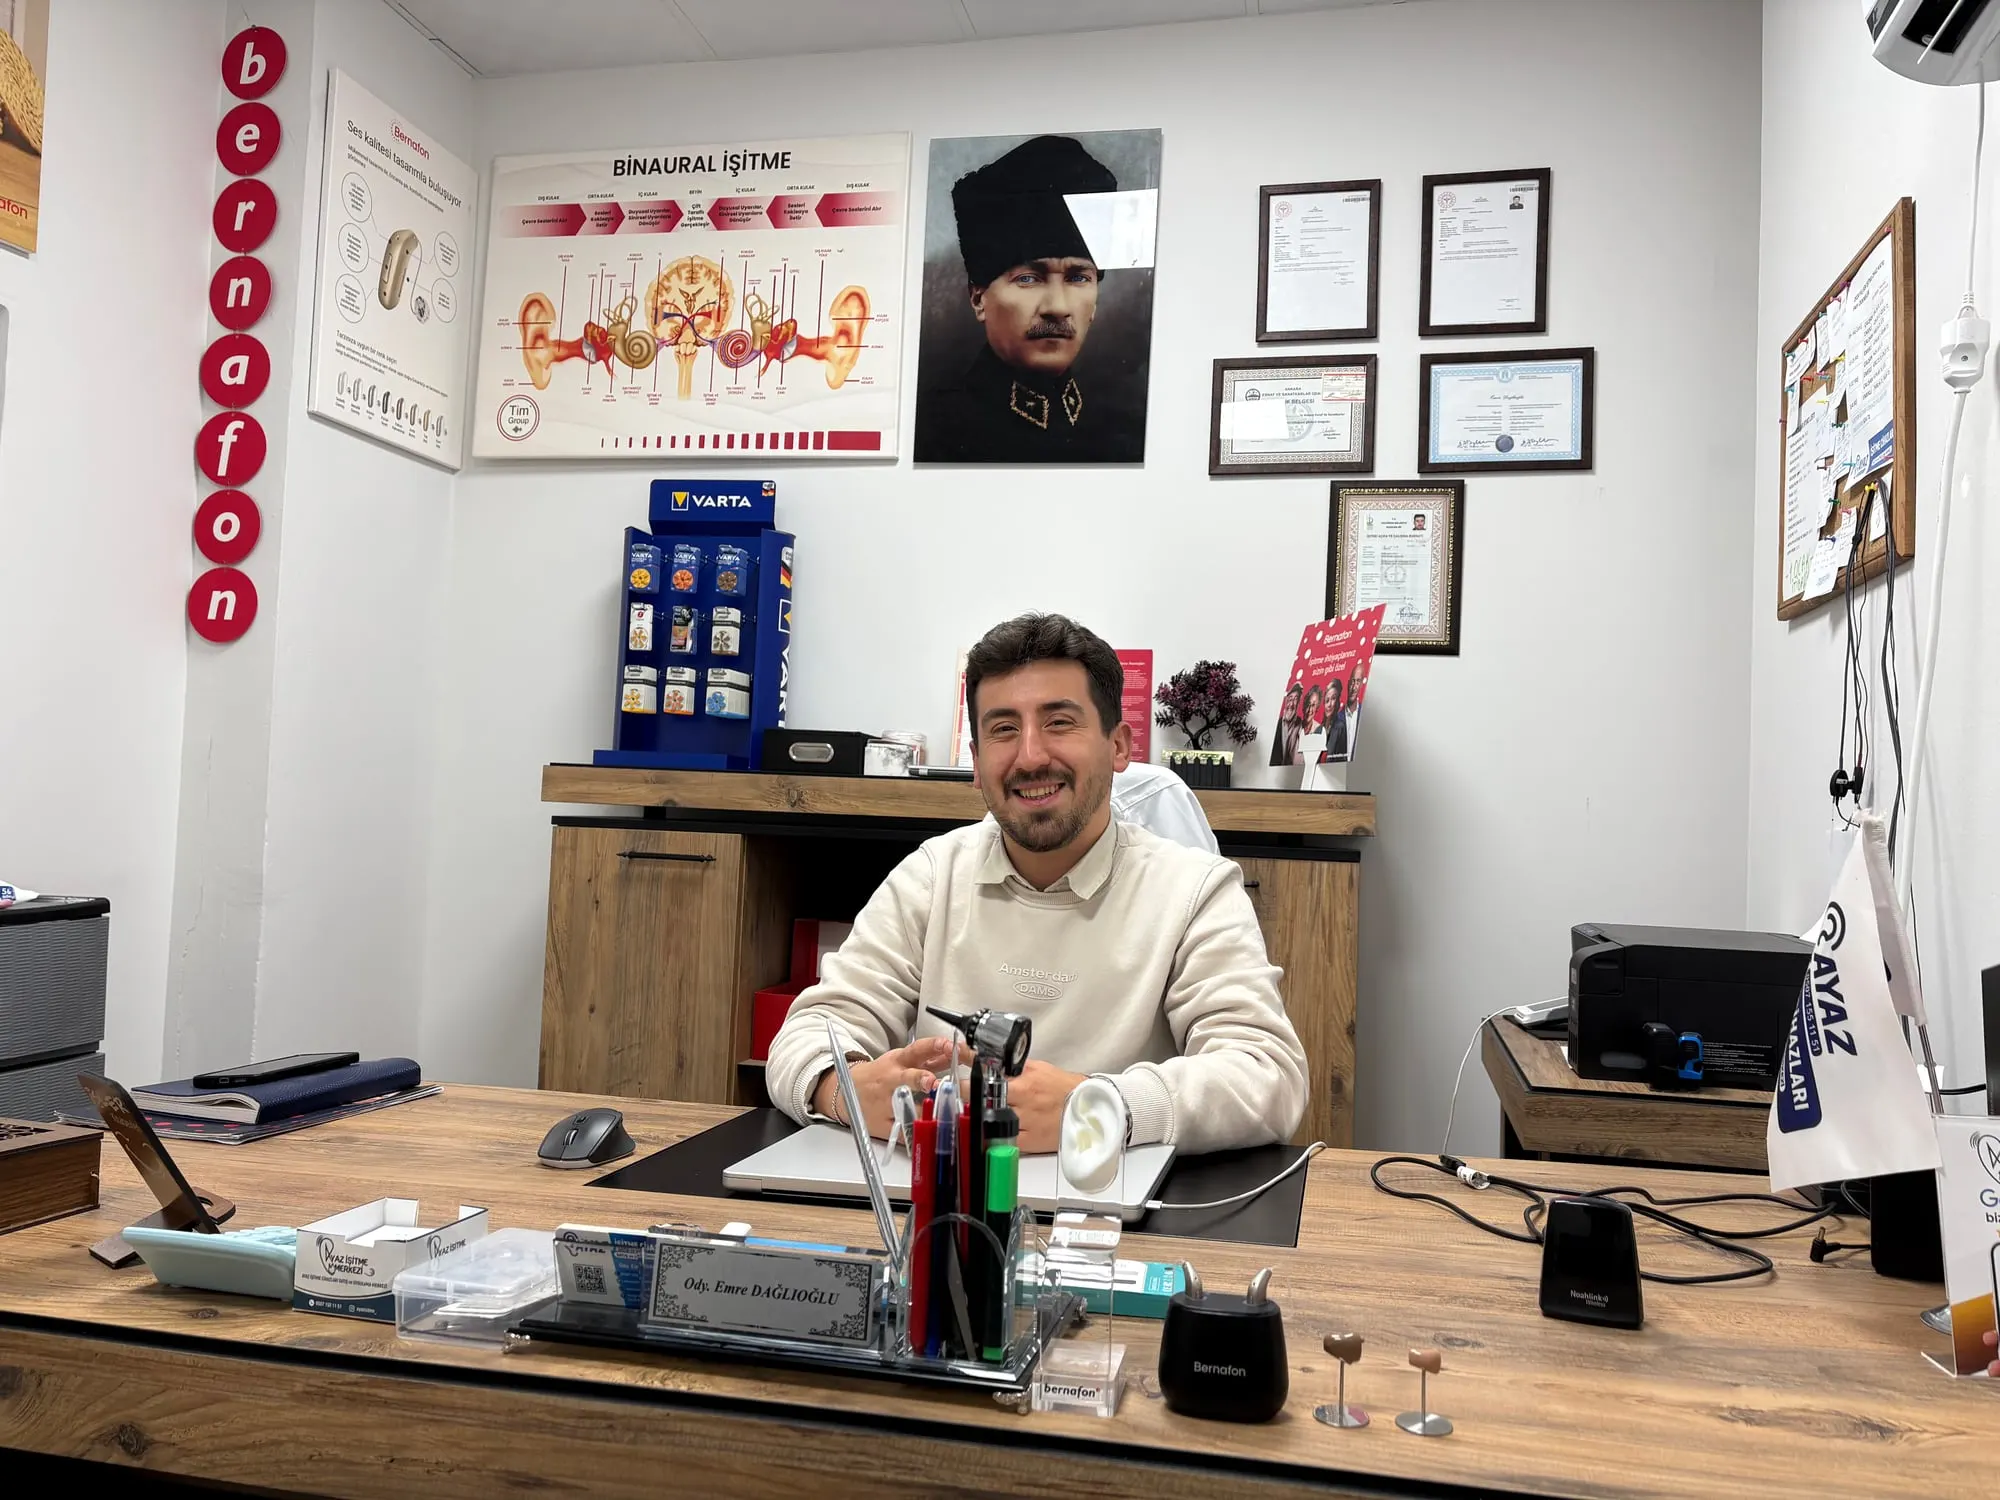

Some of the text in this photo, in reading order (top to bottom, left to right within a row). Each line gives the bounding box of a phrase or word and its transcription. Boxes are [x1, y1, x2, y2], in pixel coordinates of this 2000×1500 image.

[394, 126, 430, 160] Bernafon
[347, 119, 362, 139] Ses
[364, 131, 391, 160] kalitesi
[393, 152, 427, 185] tasarımla
[428, 176, 461, 208] buluşuyor
[613, 149, 791, 177] BİNAURAL İŞİTME
[509, 405, 529, 416] Tim
[508, 417, 529, 425] Group
[692, 495, 752, 507] VARTA
[1323, 630, 1352, 644] Bernafon
[1020, 983, 1056, 997] DAMS
[1814, 953, 1858, 1056] AYAZ
[1805, 1002, 1814, 1021] 155
[1811, 1040, 1820, 1052] 51
[345, 1254, 369, 1266] İŞİTME
[334, 1263, 364, 1275] MERKEZİ
[684, 1277, 840, 1306] Ody. Emre DAĞLIOĞLU
[1570, 1289, 1603, 1302] Noahlink
[1193, 1361, 1246, 1377] Bernafon
[1044, 1384, 1096, 1399] bernafon
